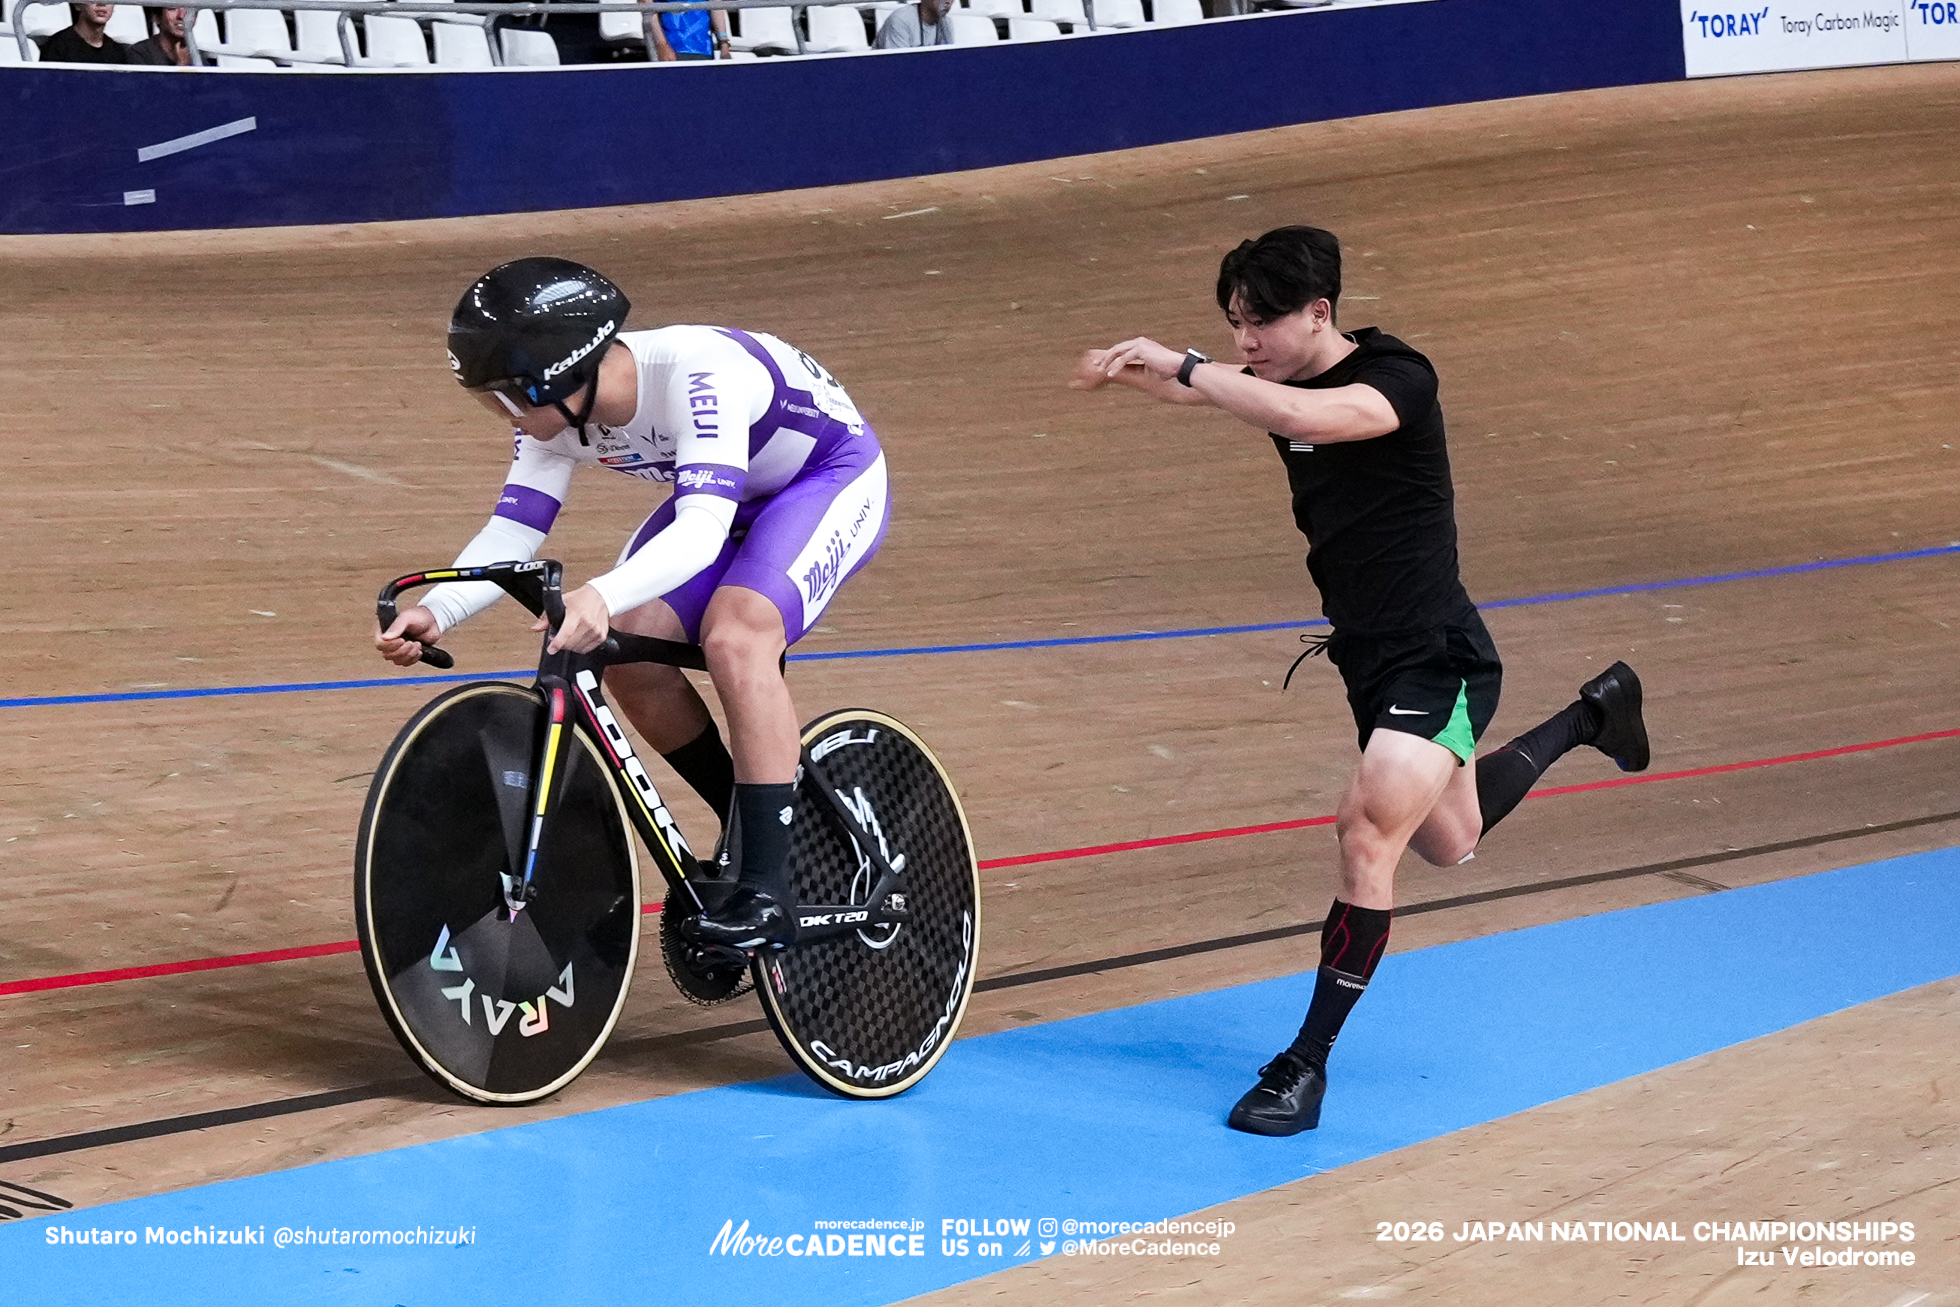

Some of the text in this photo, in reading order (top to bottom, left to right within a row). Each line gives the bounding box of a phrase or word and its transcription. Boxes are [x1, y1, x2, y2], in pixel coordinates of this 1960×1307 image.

[1780, 10, 1899, 37] Toray Carbon Magic
[544, 319, 615, 381] Kabuto
[688, 371, 718, 439] MEIJI
[677, 470, 717, 489] Meiji
[803, 530, 851, 605] Meiji
[576, 669, 694, 863] LOOK
[834, 910, 869, 924] T20
[430, 923, 575, 1038] ARAYA
[810, 909, 972, 1081] CAMPAGNOLO
